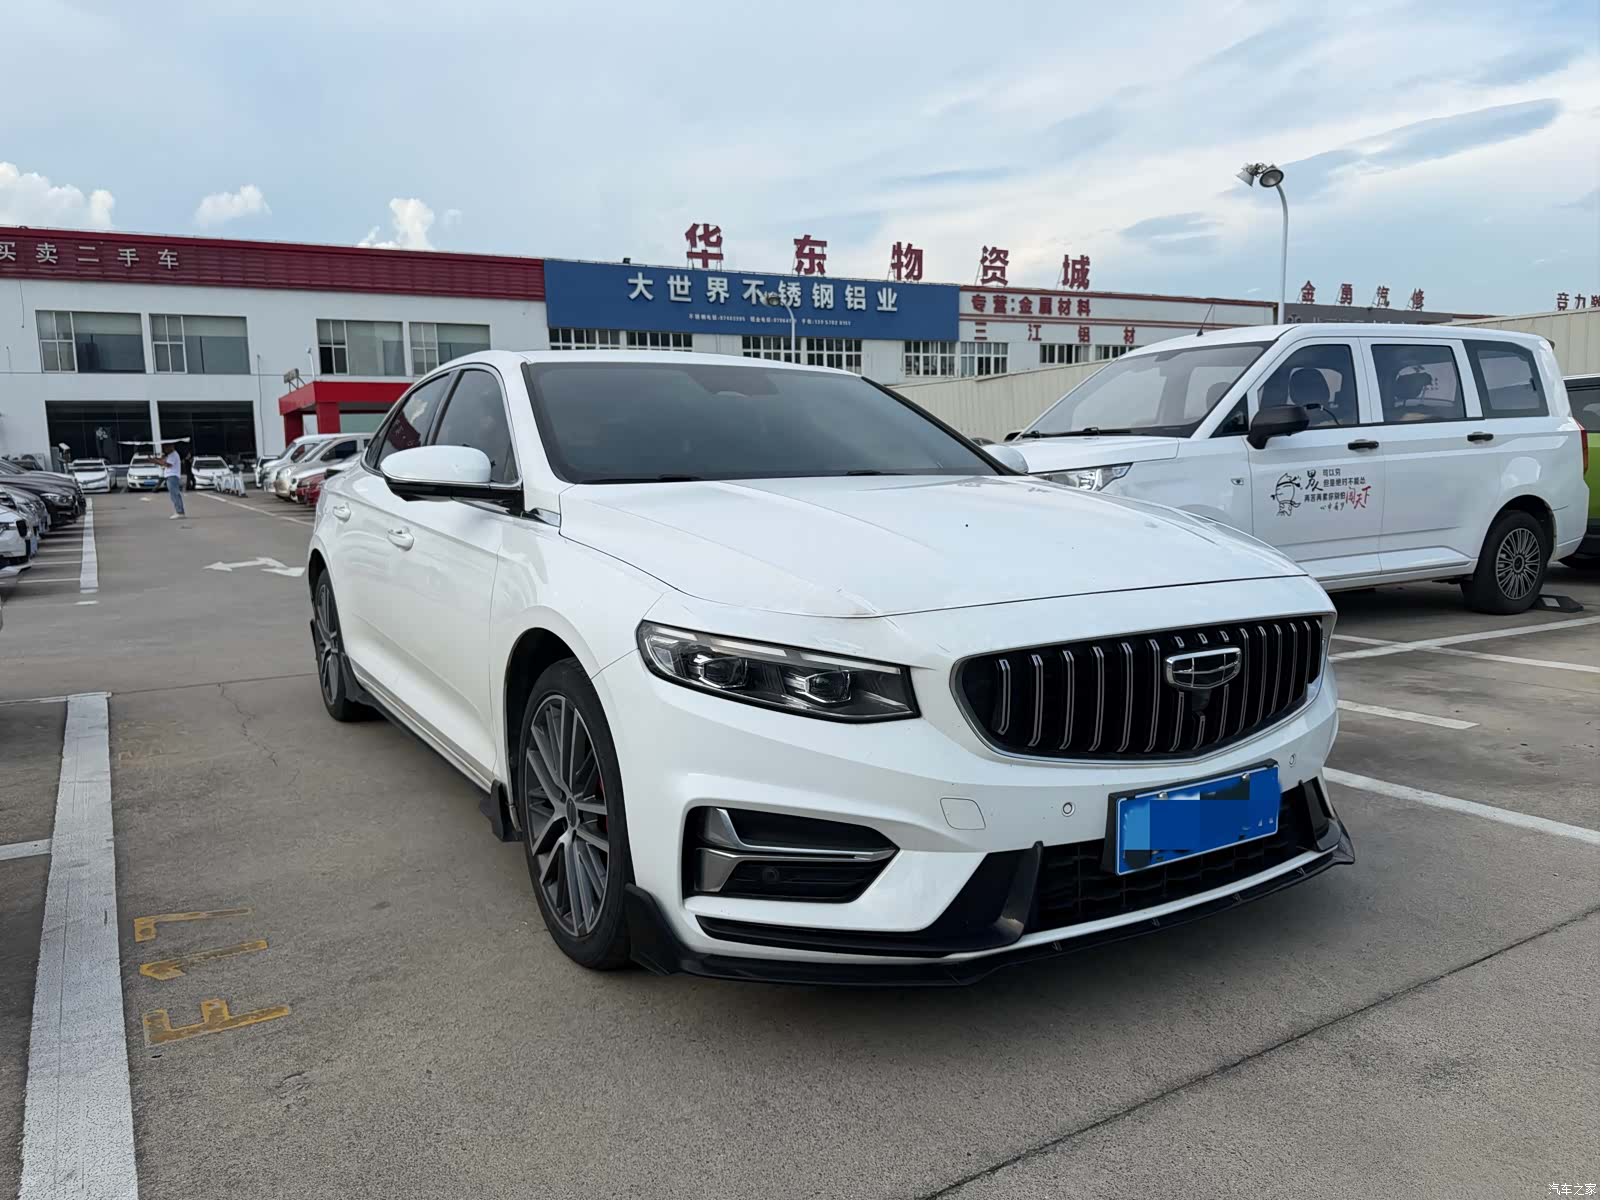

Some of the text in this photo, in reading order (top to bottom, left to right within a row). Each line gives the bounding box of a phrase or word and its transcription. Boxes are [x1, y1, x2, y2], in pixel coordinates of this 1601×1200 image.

[0, 242, 179, 270] 买卖二手车
[685, 223, 1091, 289] 华东物资城
[627, 272, 898, 313] 大世界不锈钢铝业
[971, 294, 1091, 317] 专营:金属材料
[1300, 280, 1425, 310] 金勇汽修
[974, 322, 1136, 344] 三江铝材
